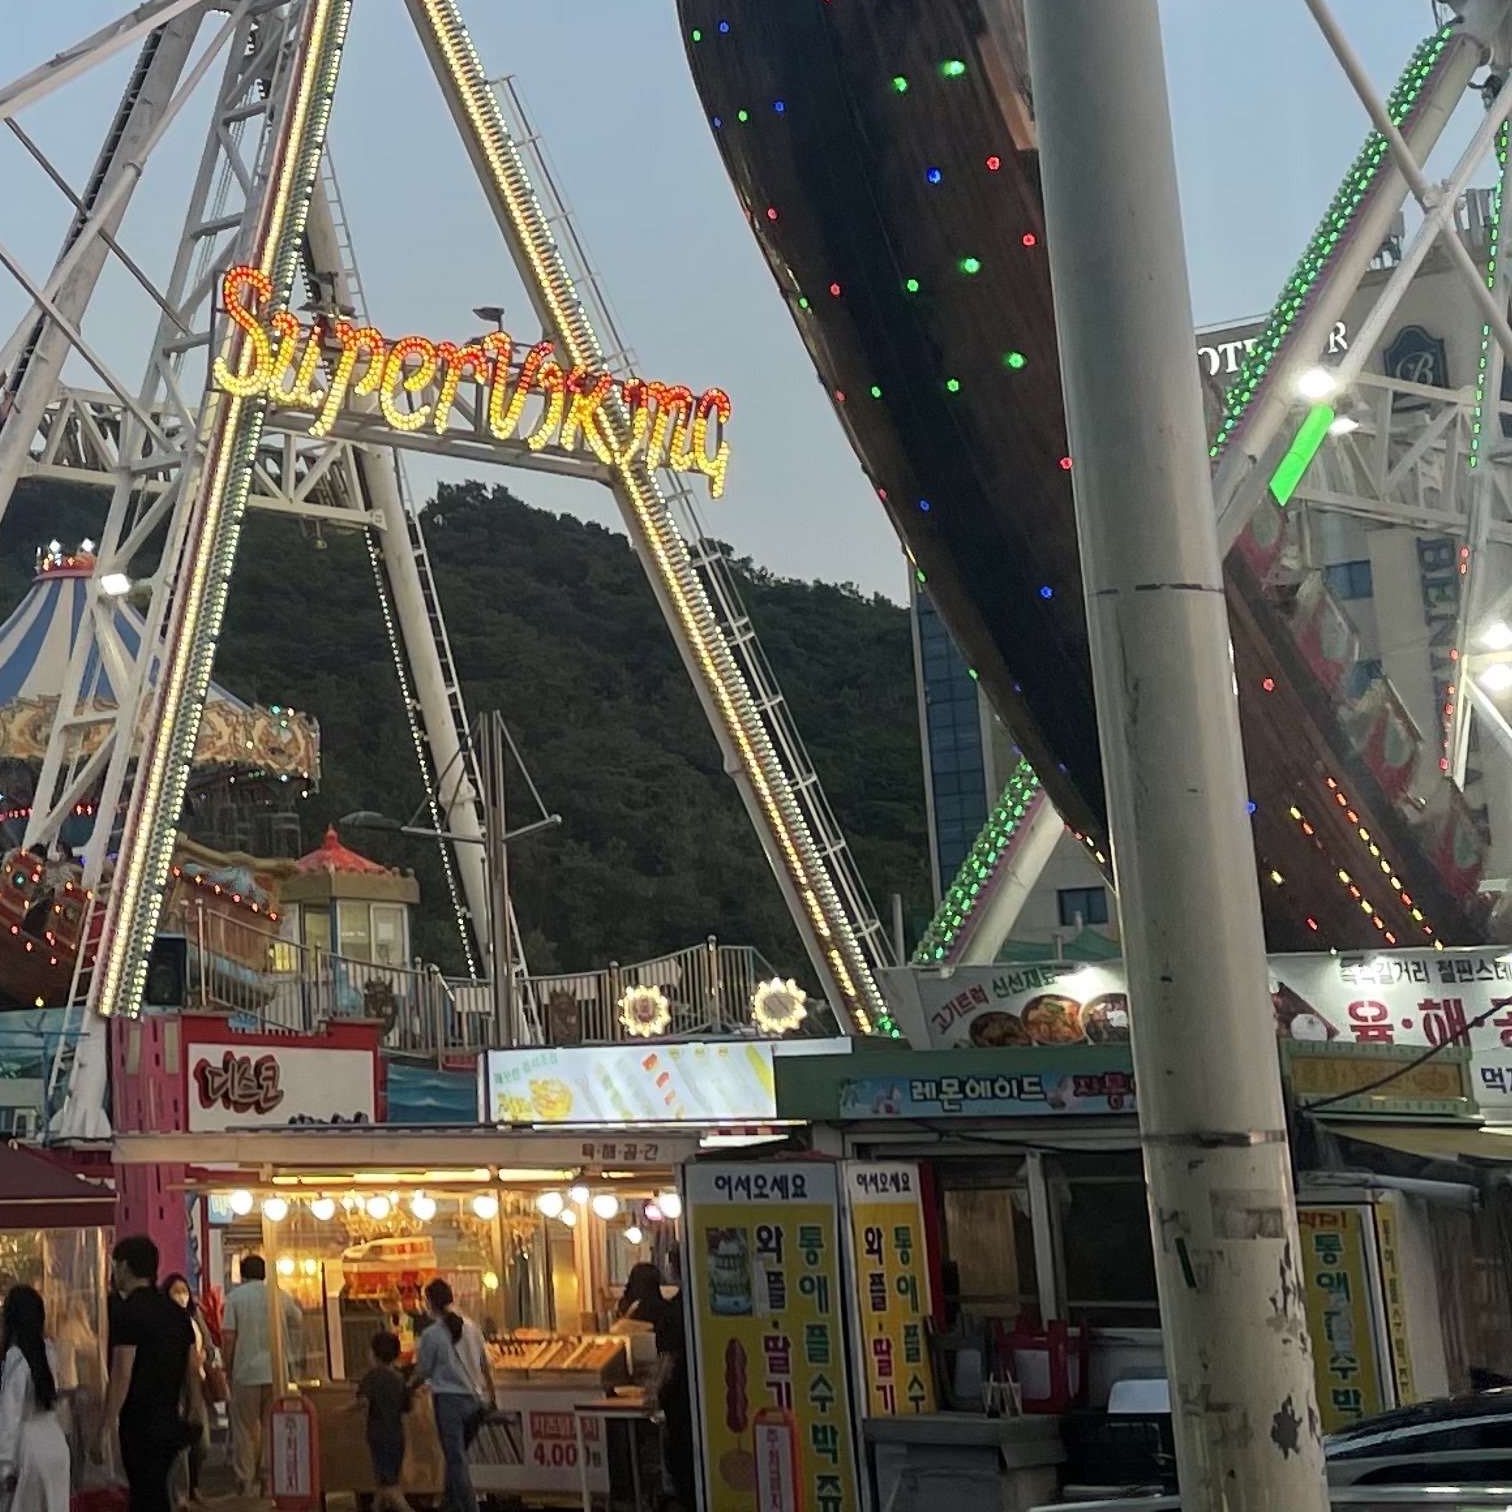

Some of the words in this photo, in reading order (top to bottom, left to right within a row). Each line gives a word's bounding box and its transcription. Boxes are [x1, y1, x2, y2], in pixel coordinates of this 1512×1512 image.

[911, 1076, 1046, 1112] 레몬에이드
[714, 1173, 808, 1201] 어서오세요
[856, 1172, 911, 1194] 어서오세요
